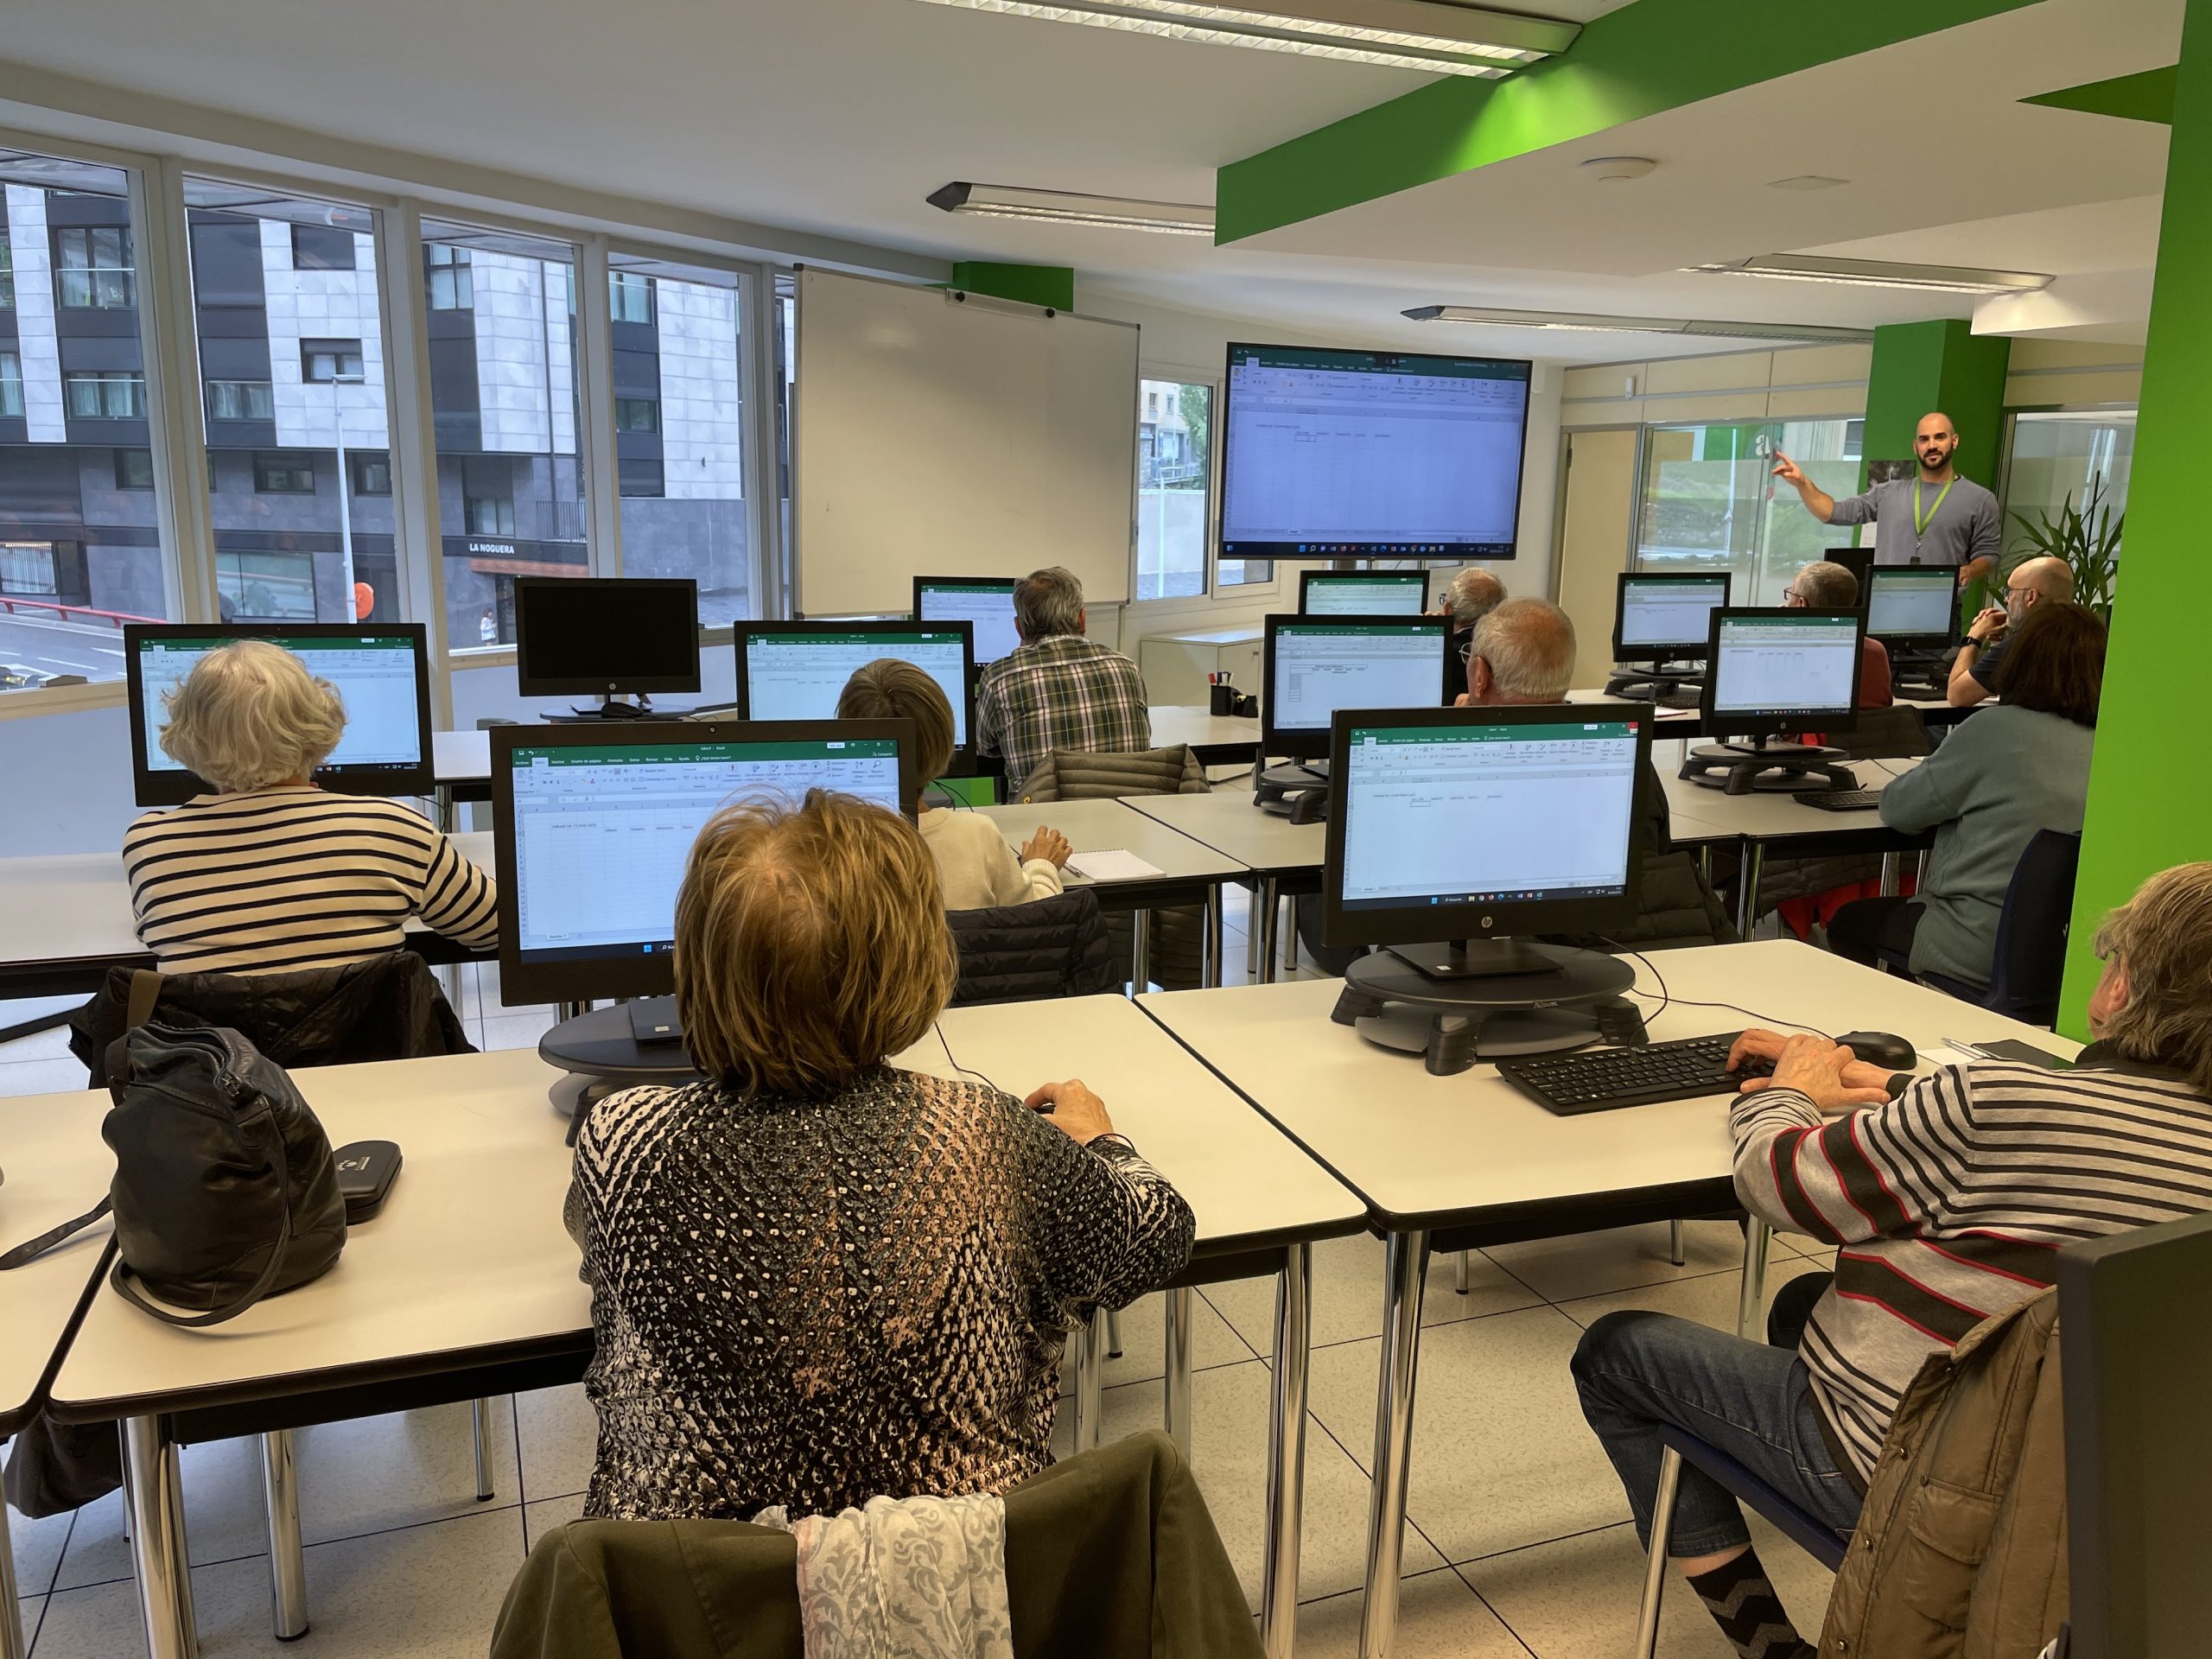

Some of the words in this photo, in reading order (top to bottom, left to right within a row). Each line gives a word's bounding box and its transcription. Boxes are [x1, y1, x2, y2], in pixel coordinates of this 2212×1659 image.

[469, 543, 480, 552] LA
[480, 543, 515, 555] NOGUERA
[1481, 916, 1493, 929] hp
